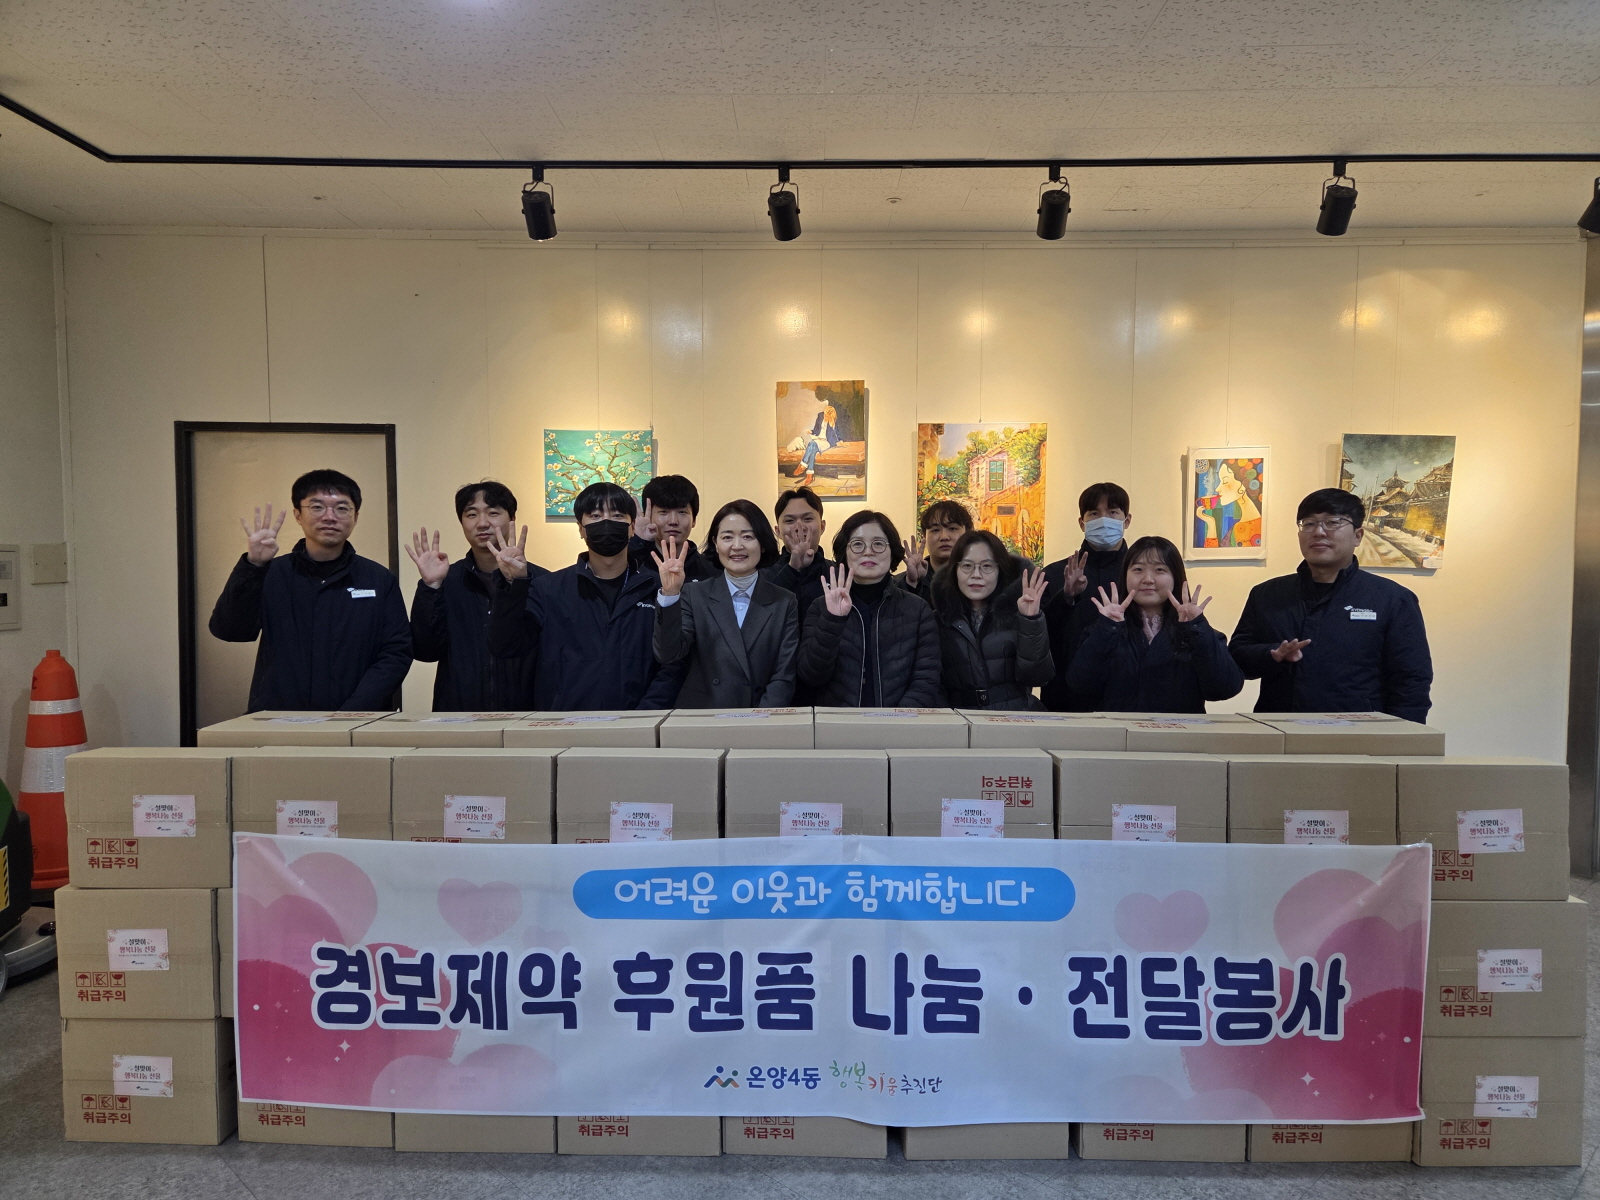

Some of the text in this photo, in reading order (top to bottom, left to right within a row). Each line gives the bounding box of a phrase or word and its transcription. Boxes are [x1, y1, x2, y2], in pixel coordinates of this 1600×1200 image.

[981, 775, 1033, 789] 취급주의
[87, 856, 139, 870] 취급주의
[1433, 868, 1473, 882] 급주의
[615, 871, 1034, 914] 어려운 이웃과 함께합니다
[77, 990, 127, 1002] 취급주의
[316, 947, 582, 1031] 경보제약
[613, 951, 815, 1032] 후원품
[852, 952, 983, 1035] 나눔
[1068, 954, 1346, 1040] 전달봉사
[1440, 1004, 1492, 1018] 취급주의
[746, 1065, 822, 1090] 온양4동
[83, 1111, 132, 1125] 취급주의
[258, 1113, 306, 1127] 취급주의
[578, 1124, 629, 1137] 취급주의
[743, 1126, 795, 1140] 취급주의
[1103, 1127, 1154, 1142] 취급주의
[1271, 1130, 1323, 1144] 취급주의
[1439, 1136, 1491, 1150] 취급주의
